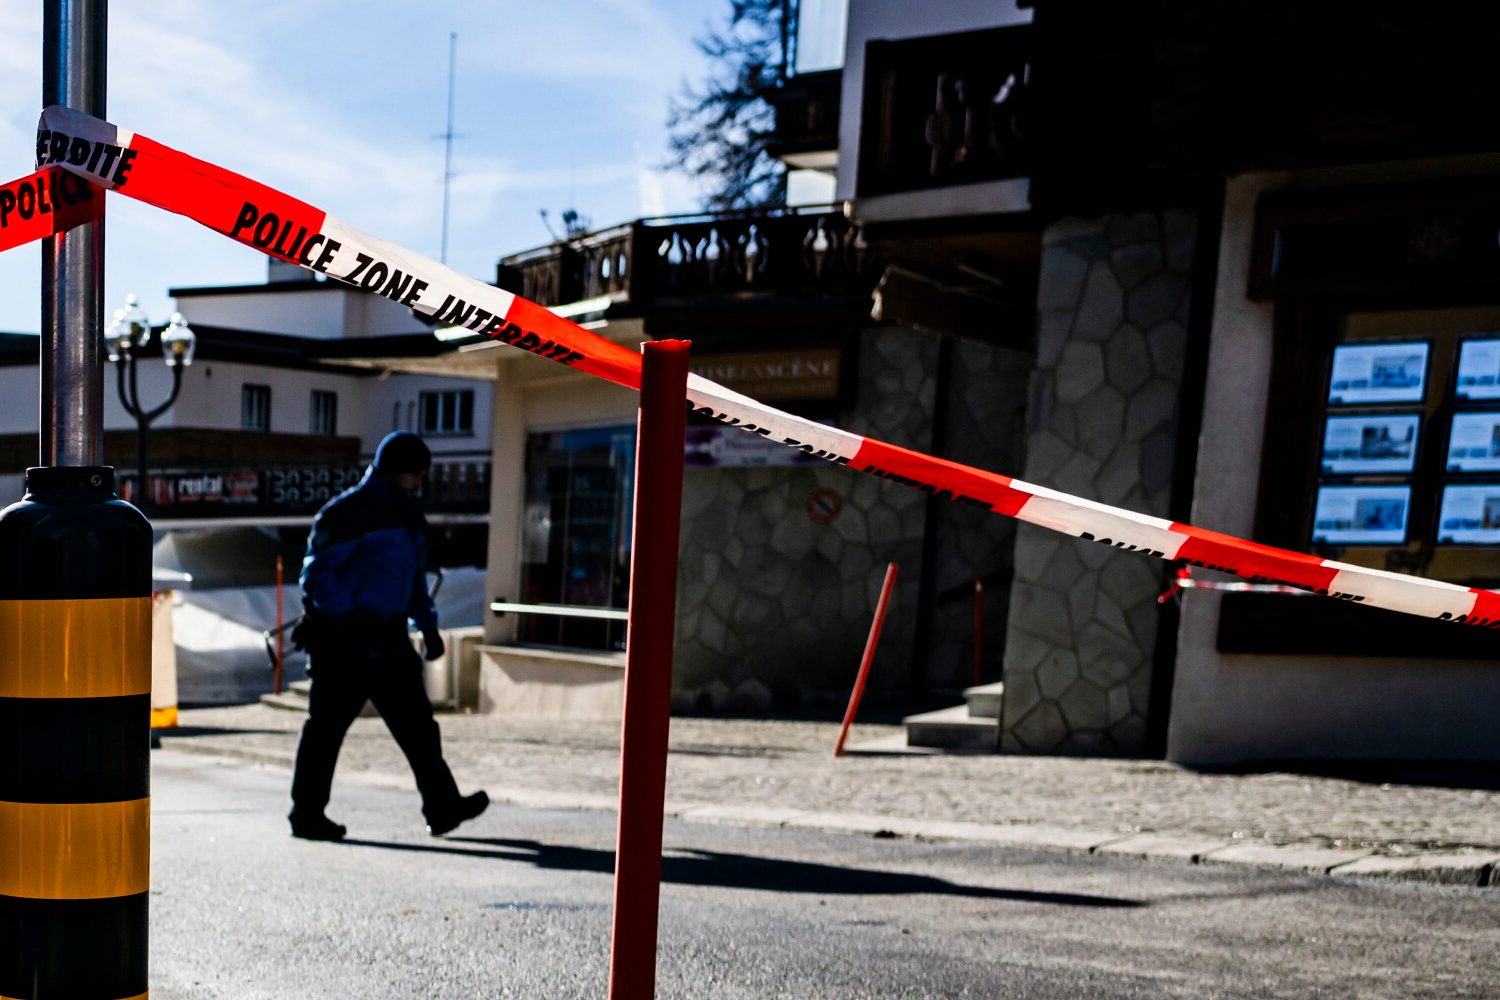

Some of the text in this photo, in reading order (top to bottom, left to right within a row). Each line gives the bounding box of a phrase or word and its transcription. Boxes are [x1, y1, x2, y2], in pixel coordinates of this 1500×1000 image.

[37, 130, 138, 186] ERDITE
[230, 202, 342, 273] POLICE
[341, 252, 429, 308] ZONE
